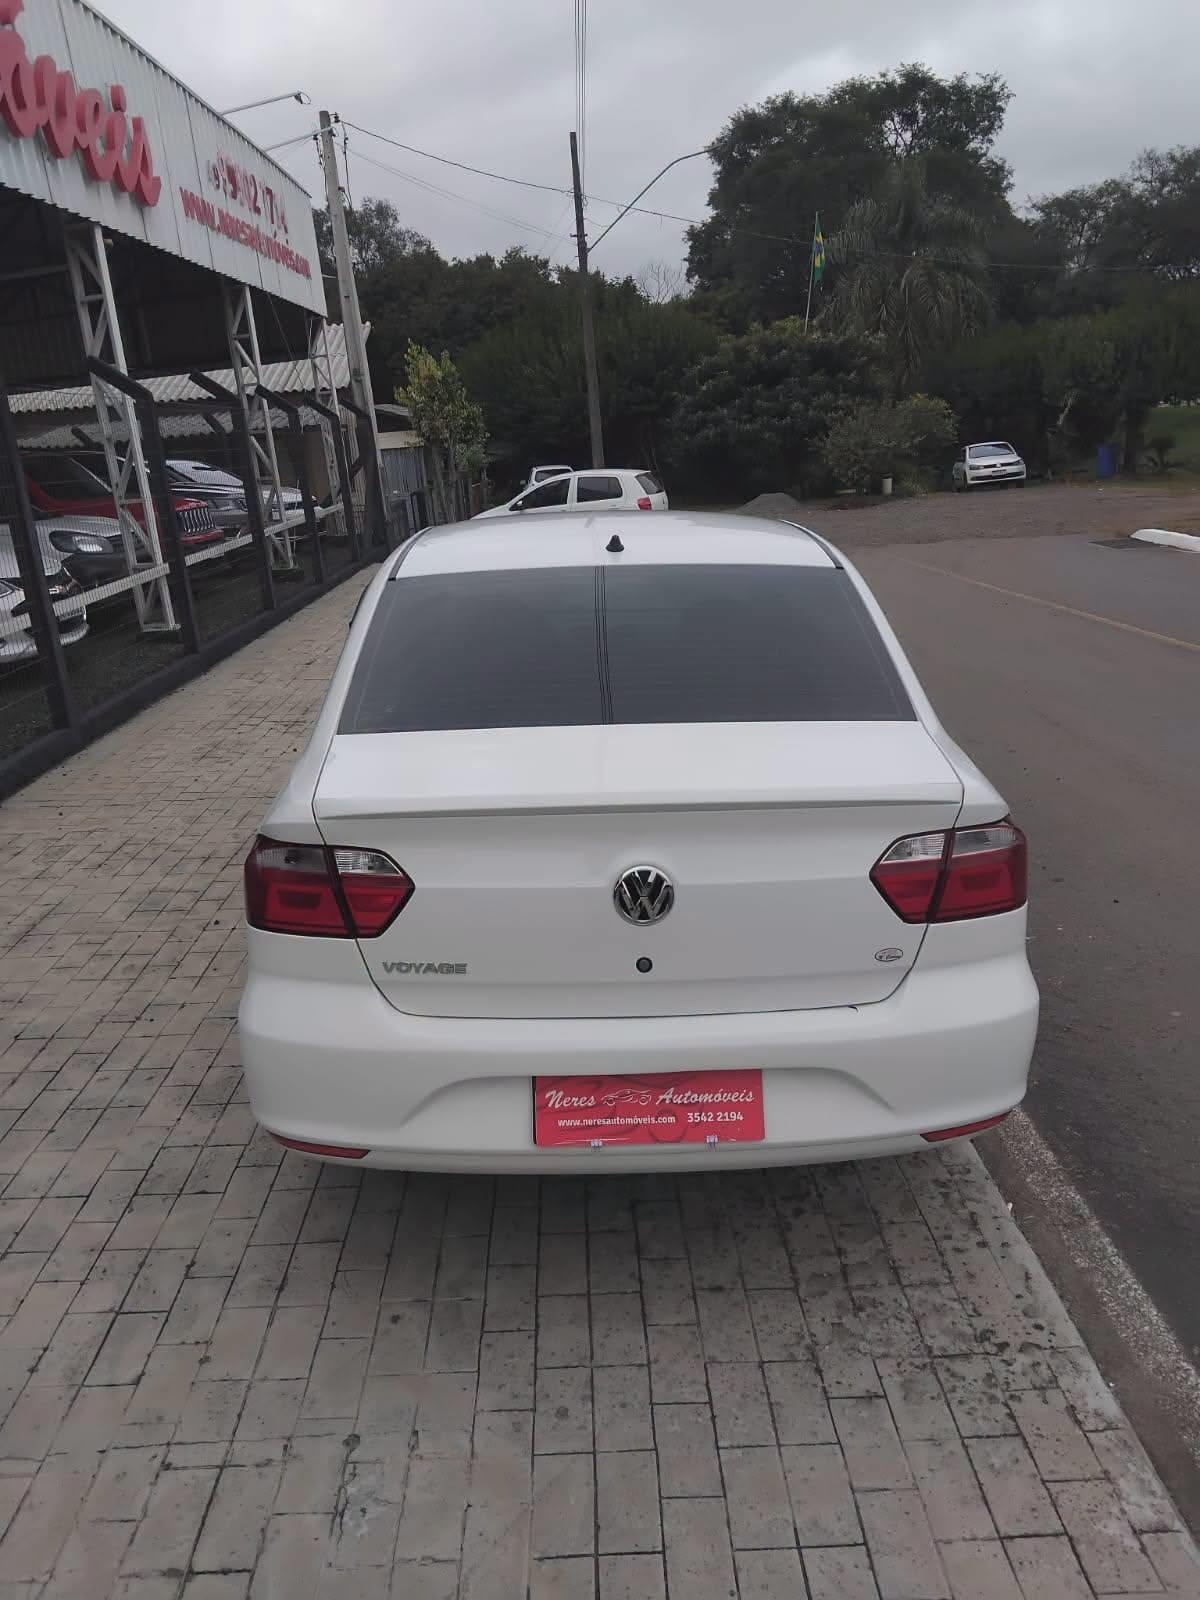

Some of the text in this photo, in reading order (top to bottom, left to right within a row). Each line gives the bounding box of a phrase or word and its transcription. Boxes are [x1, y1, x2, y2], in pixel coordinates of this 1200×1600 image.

[382, 961, 468, 975] VOYAGE
[545, 1087, 755, 1109] Neres Automóveis
[687, 1111, 714, 1123] 3542
[716, 1111, 744, 1122] 2194
